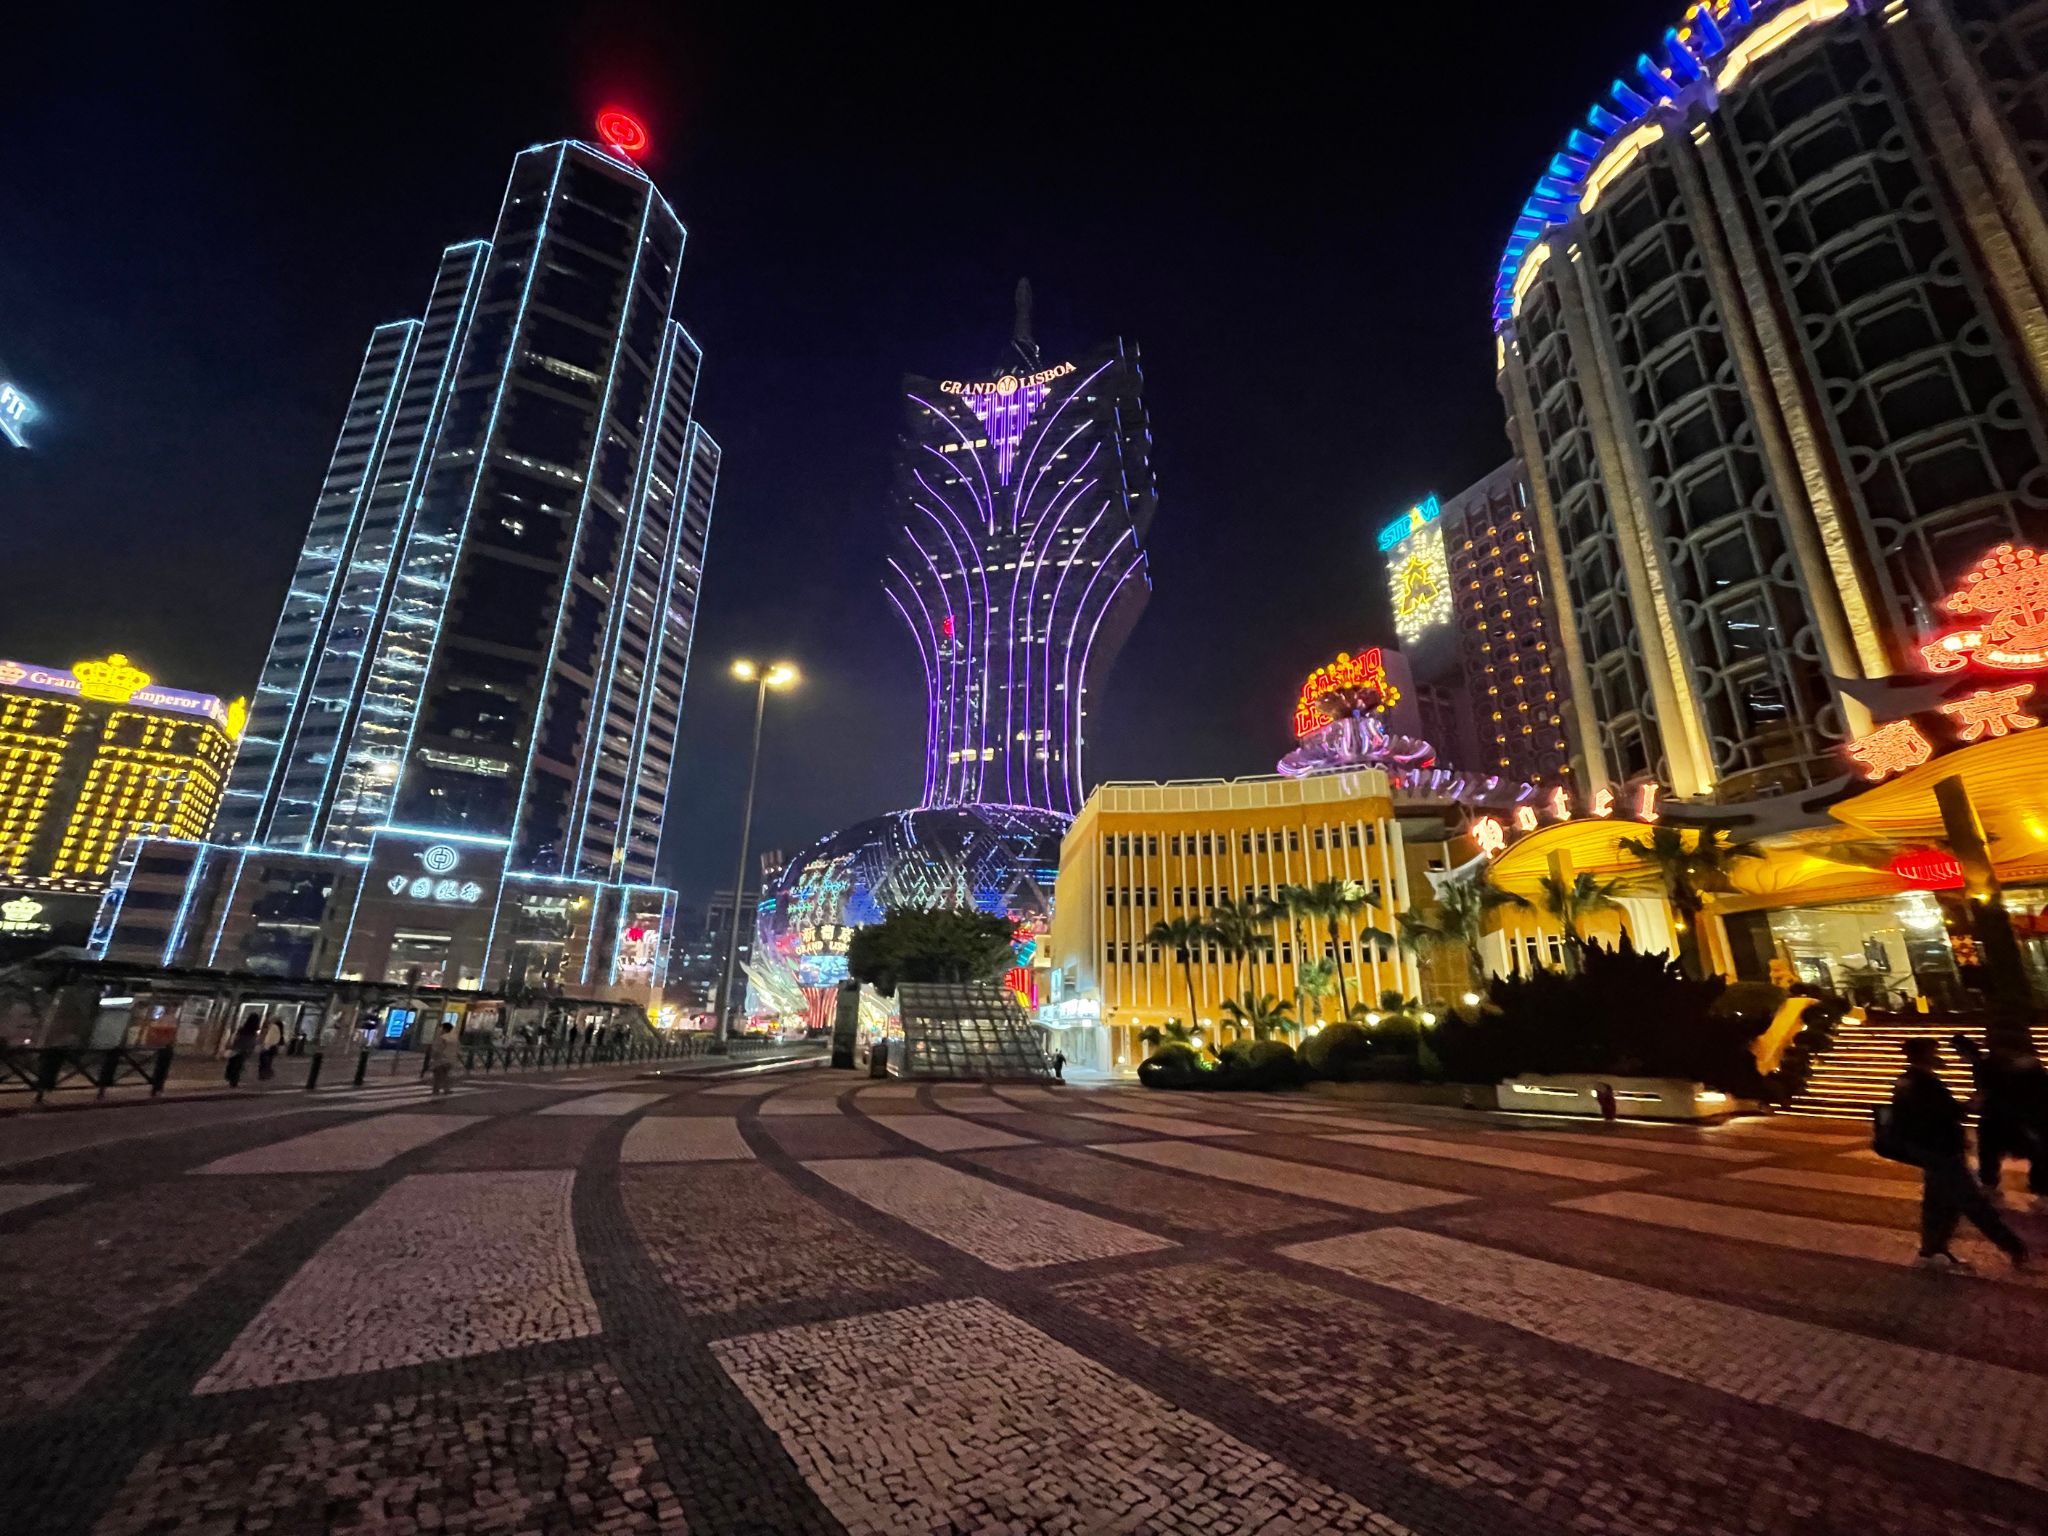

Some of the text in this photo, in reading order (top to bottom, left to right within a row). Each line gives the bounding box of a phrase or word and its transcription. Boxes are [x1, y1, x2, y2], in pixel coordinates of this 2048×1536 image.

[940, 361, 1077, 395] GRAND LISBOA
[1303, 647, 1381, 706] CASINO
[1848, 683, 2040, 780] 葡京
[795, 941, 824, 955] GRAND
